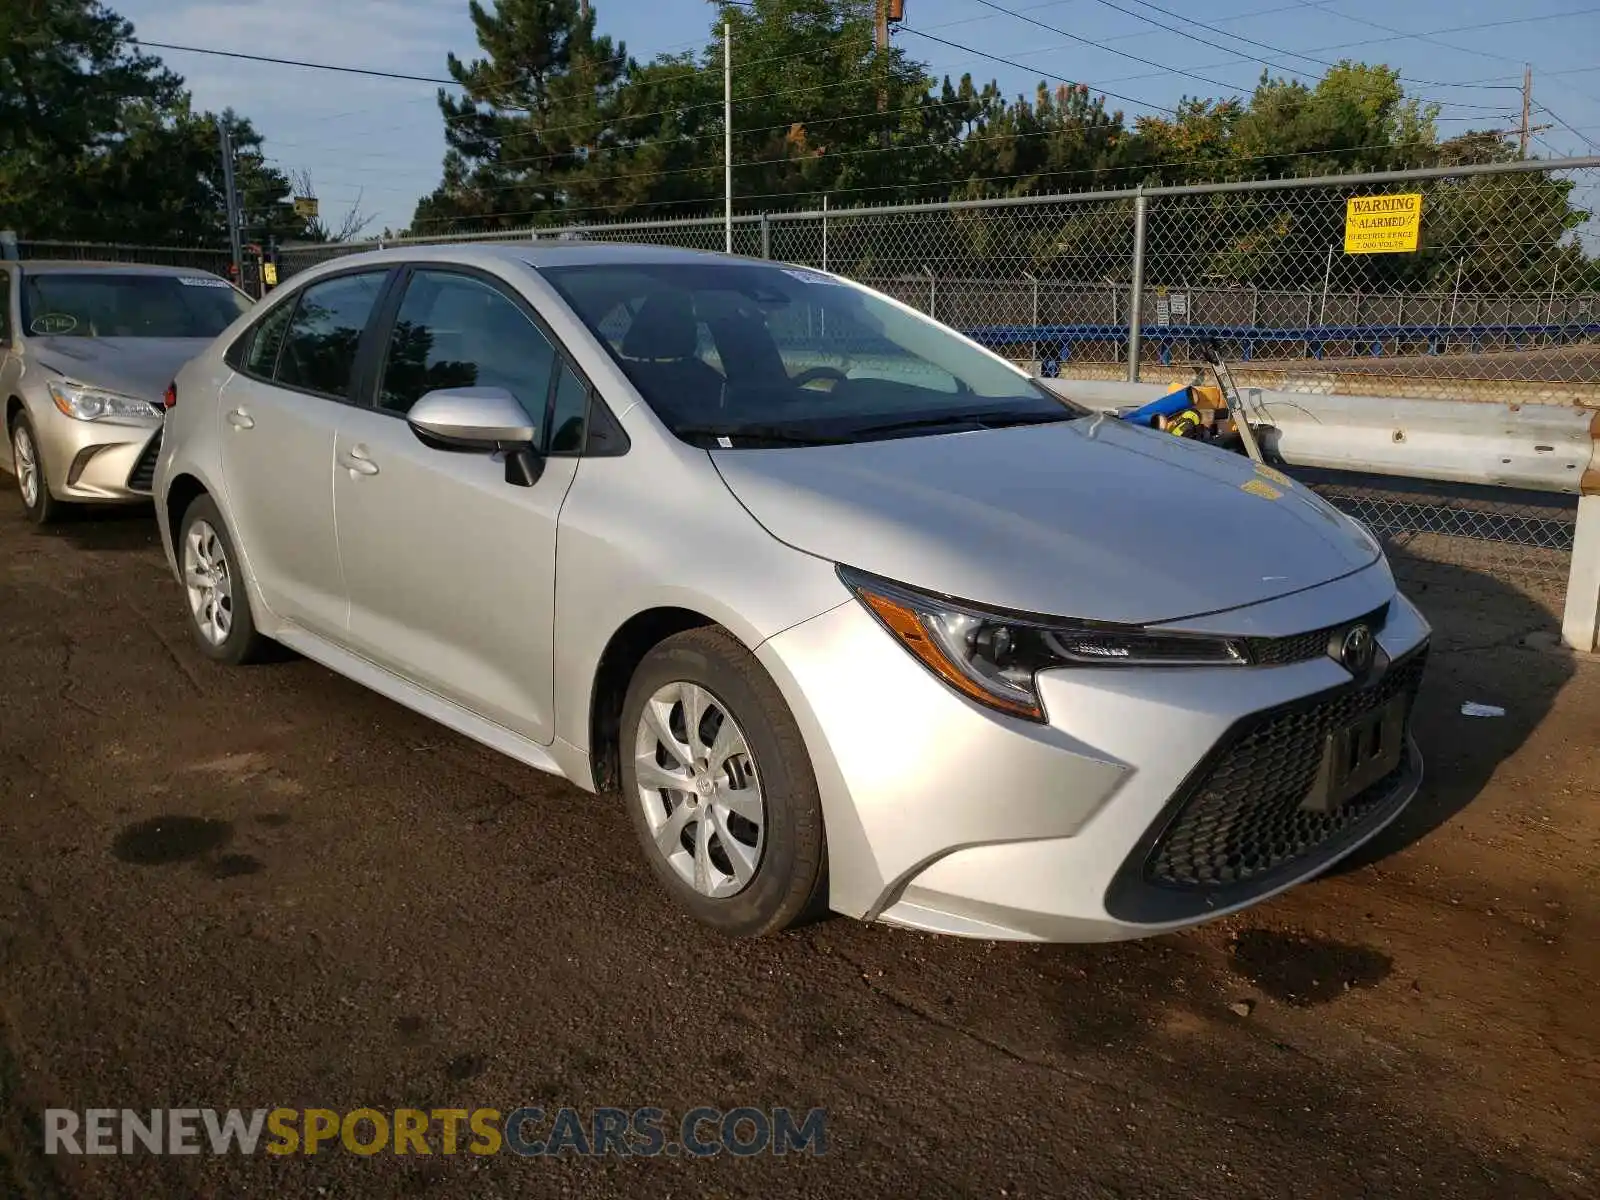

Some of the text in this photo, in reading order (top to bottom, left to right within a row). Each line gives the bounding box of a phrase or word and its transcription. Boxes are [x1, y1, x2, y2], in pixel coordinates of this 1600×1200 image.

[1353, 198, 1415, 212] WARNING
[1359, 216, 1405, 229] ALARMED
[1348, 232, 1385, 241] ELECTRIC
[1378, 240, 1404, 248] VOLTS
